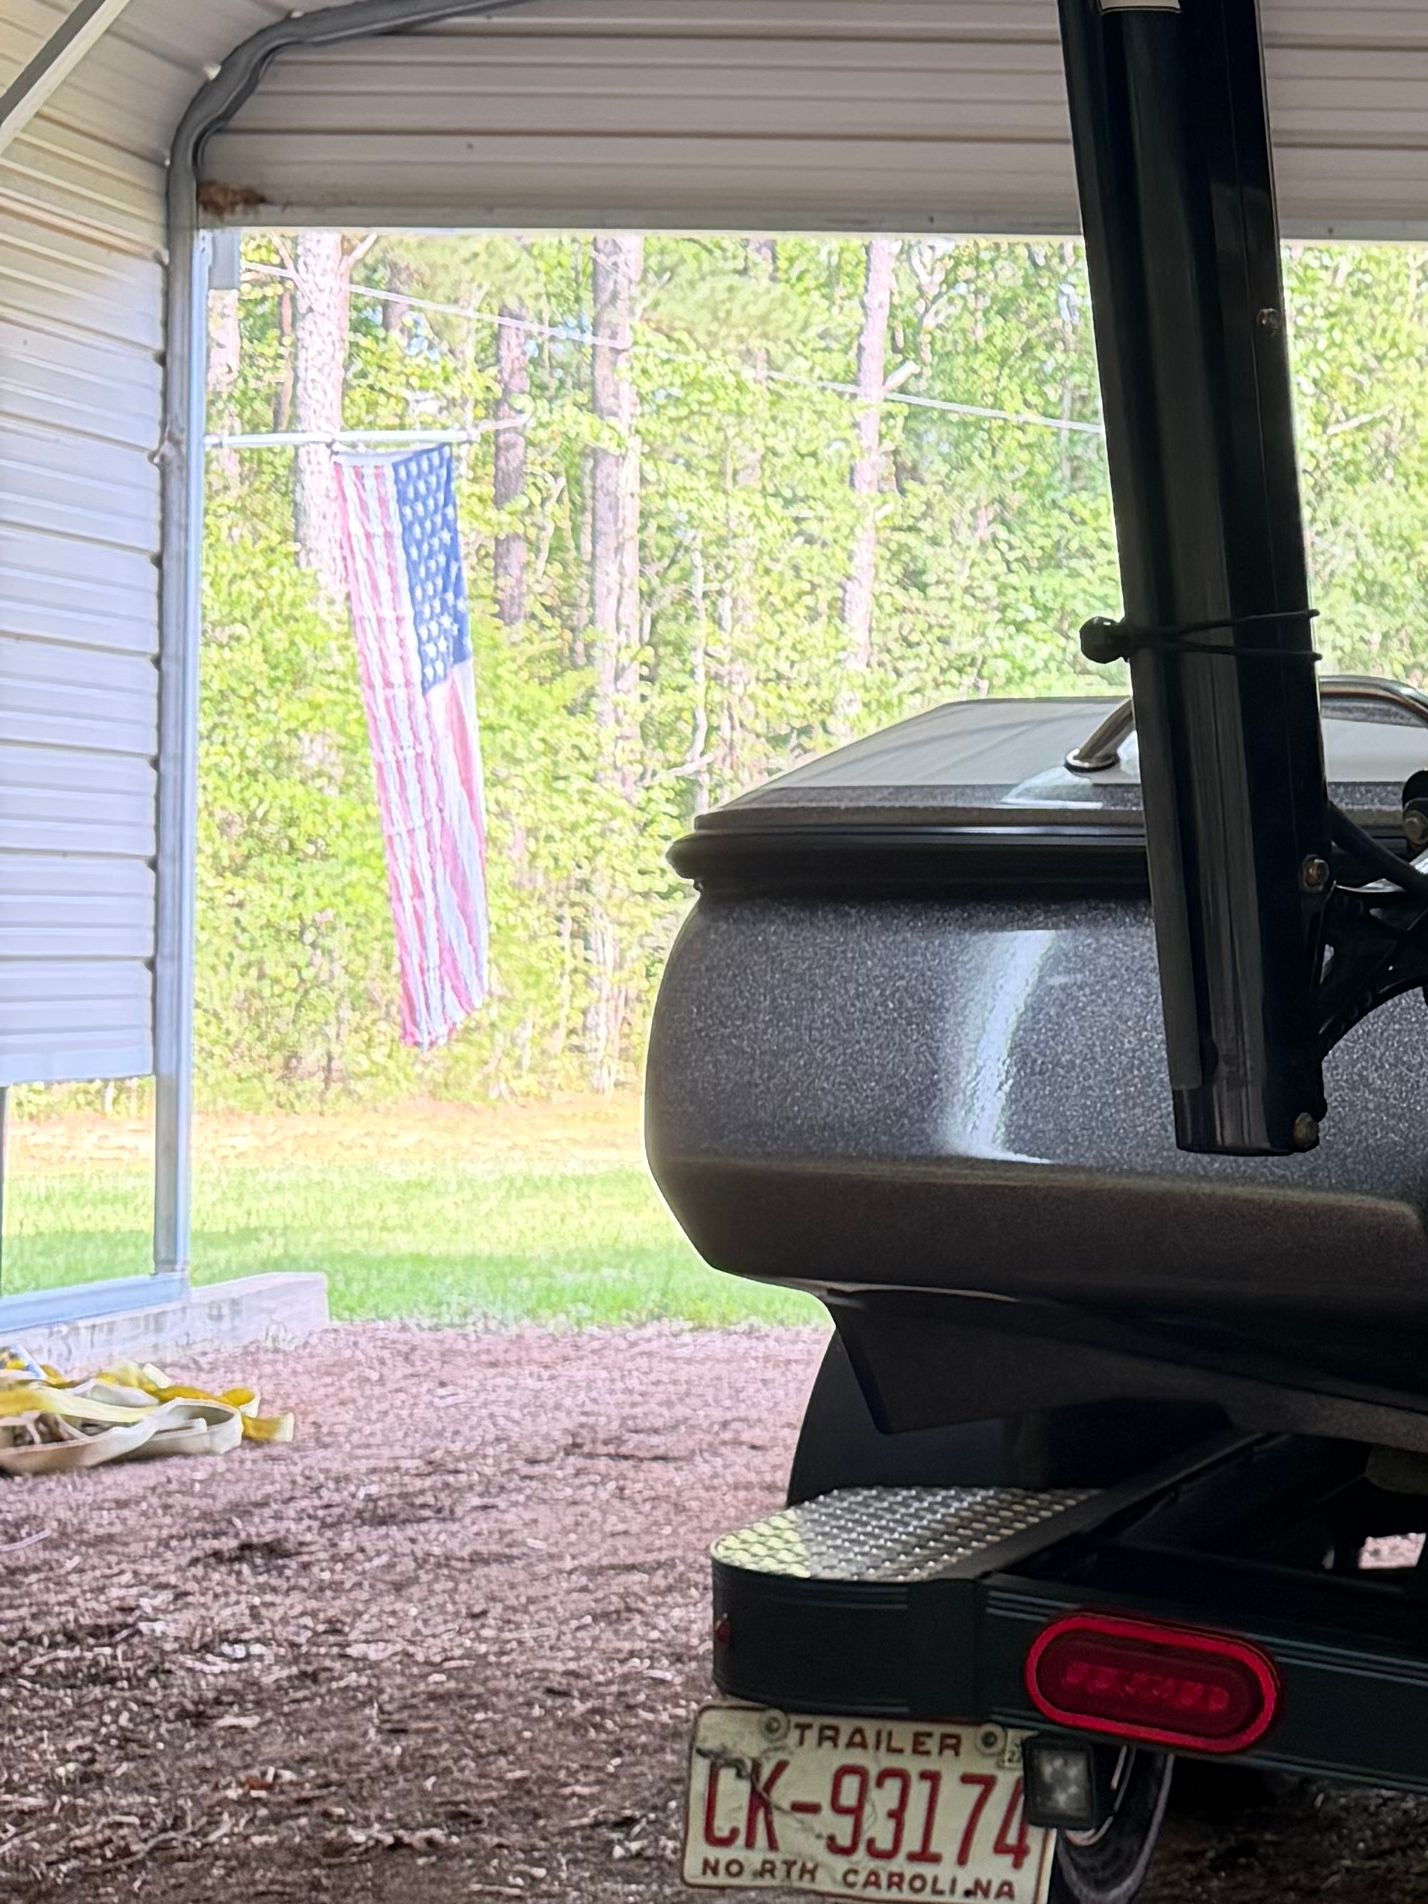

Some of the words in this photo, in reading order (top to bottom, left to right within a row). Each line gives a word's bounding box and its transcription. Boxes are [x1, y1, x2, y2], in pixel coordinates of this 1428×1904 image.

[793, 1722, 963, 1758] TRAILER
[703, 1758, 1031, 1871] CK-93174
[701, 1856, 818, 1883] NORTH
[842, 1867, 1017, 1902] CAROLINA
